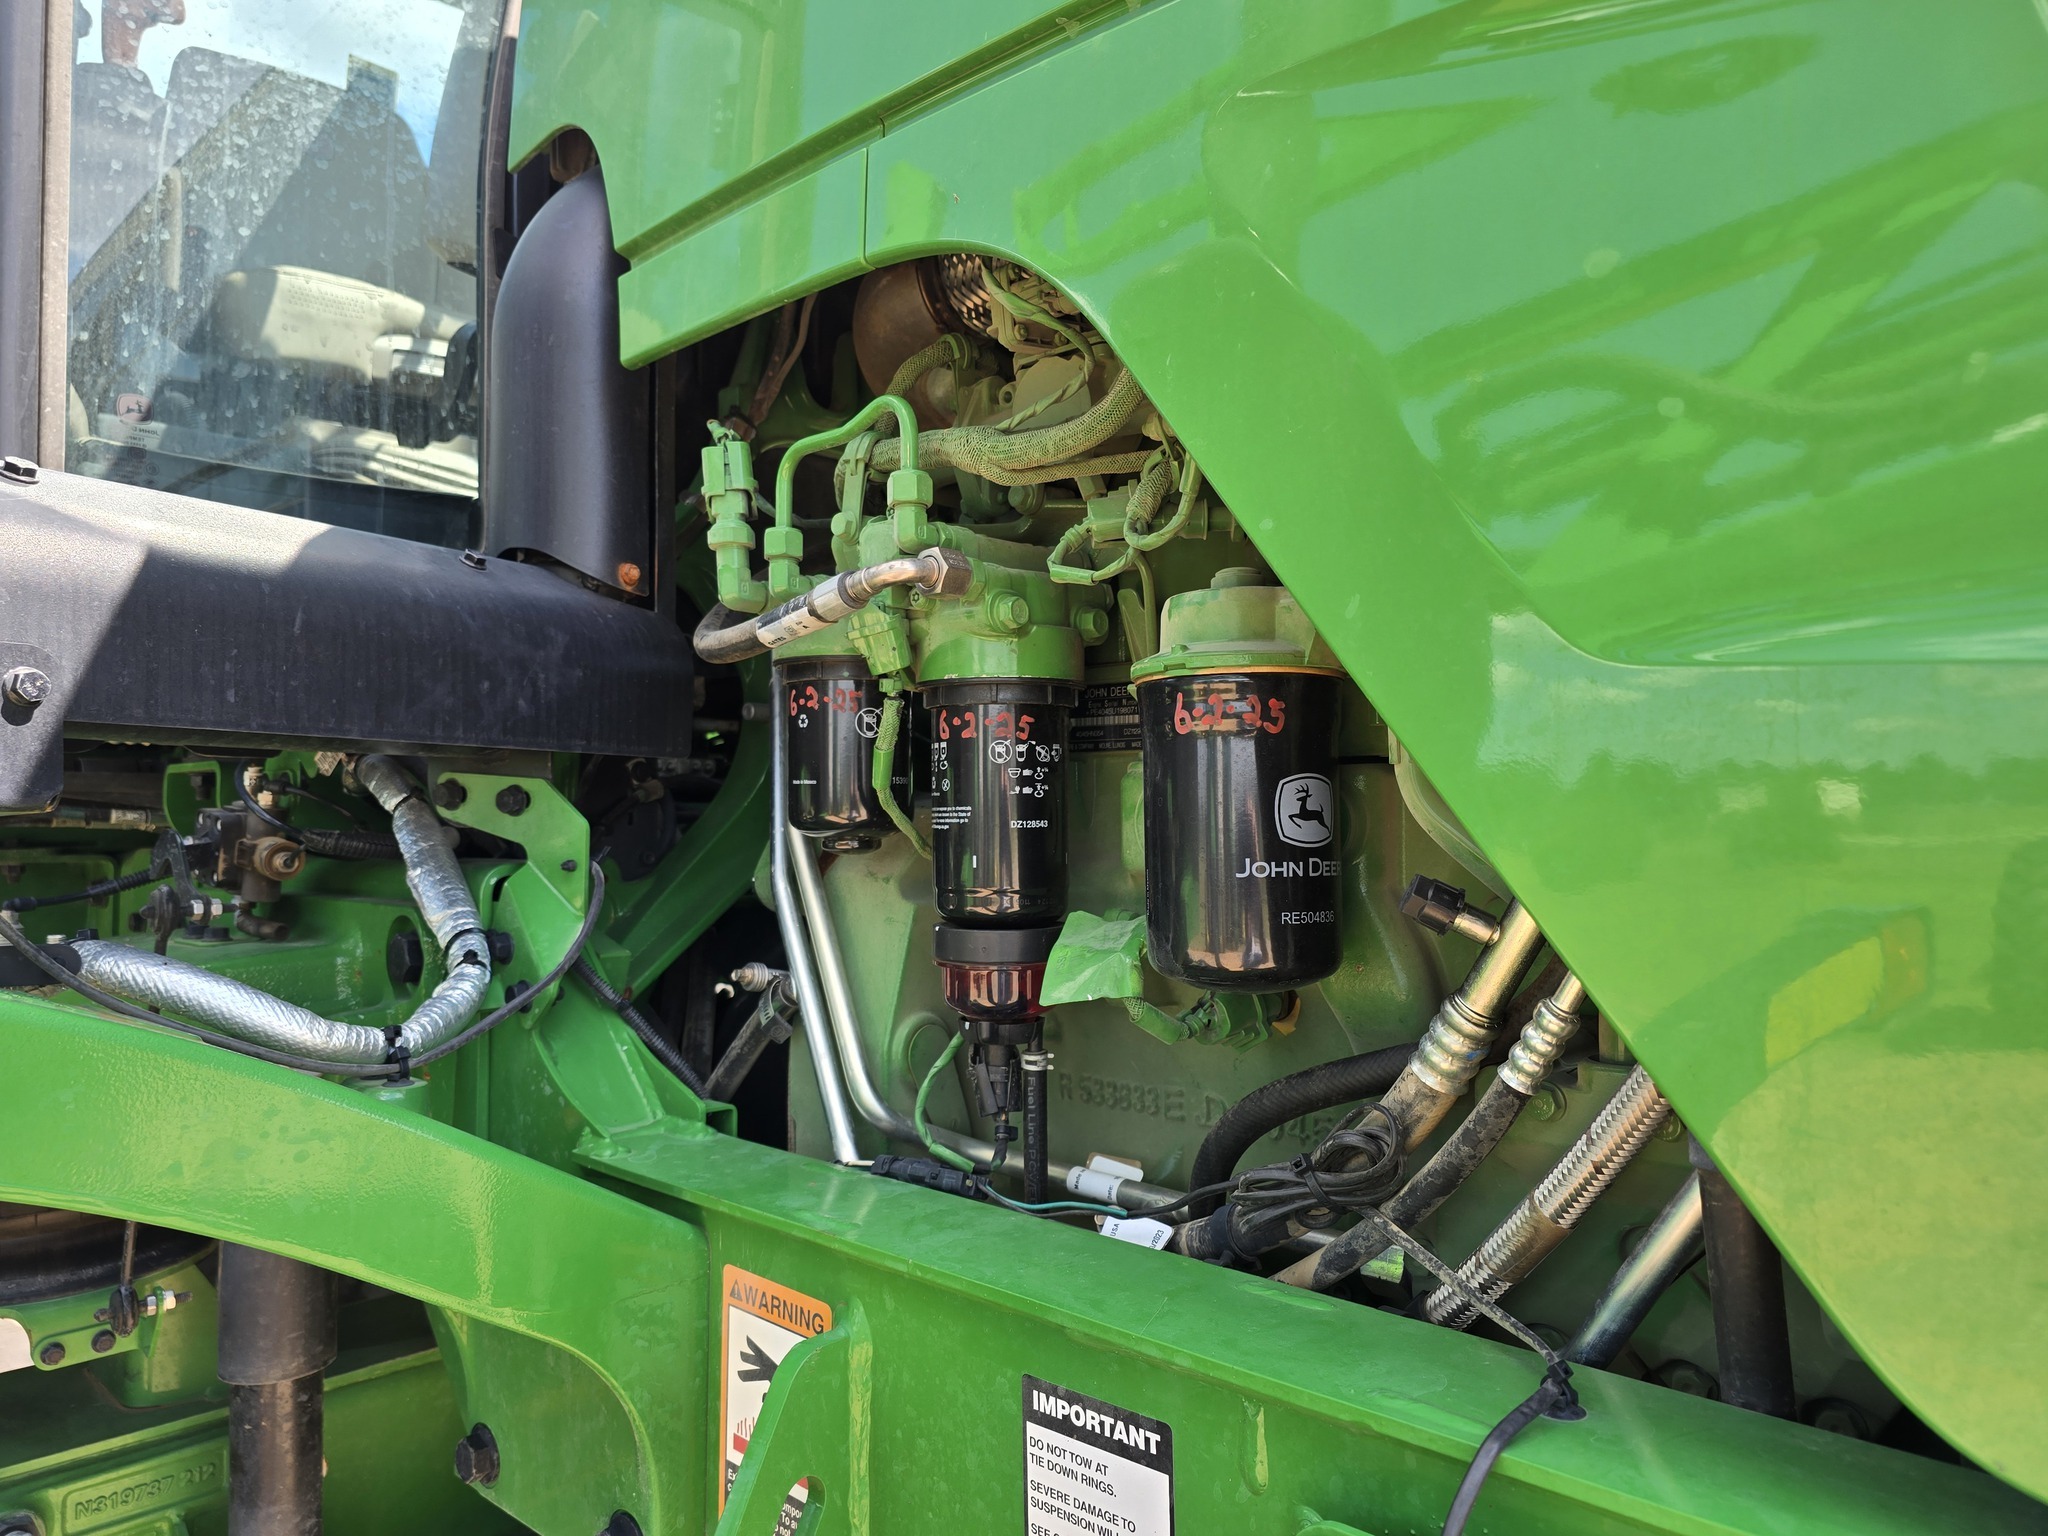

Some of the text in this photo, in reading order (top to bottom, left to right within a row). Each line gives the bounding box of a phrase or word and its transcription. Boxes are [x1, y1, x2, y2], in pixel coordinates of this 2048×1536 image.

[1085, 686, 1130, 698] JOHN DEE
[1010, 820, 1049, 829] DZ128543
[1235, 857, 1304, 878] JOHN
[1281, 910, 1335, 925] RE504836
[1027, 1076, 1037, 1109] Fuel
[1027, 1113, 1037, 1144] Line
[1110, 1223, 1120, 1237] USA
[743, 1282, 824, 1335] WARNING
[1032, 1389, 1161, 1455] IMPORTANT
[1029, 1436, 1109, 1477] DO NOT TOW AT
[1029, 1452, 1117, 1498] TIE DOWN RINGS.
[780, 1512, 791, 1526] To
[1030, 1479, 1136, 1533] SEVERE DAMAGE TO
[1030, 1496, 1096, 1533] SUSPENSION
